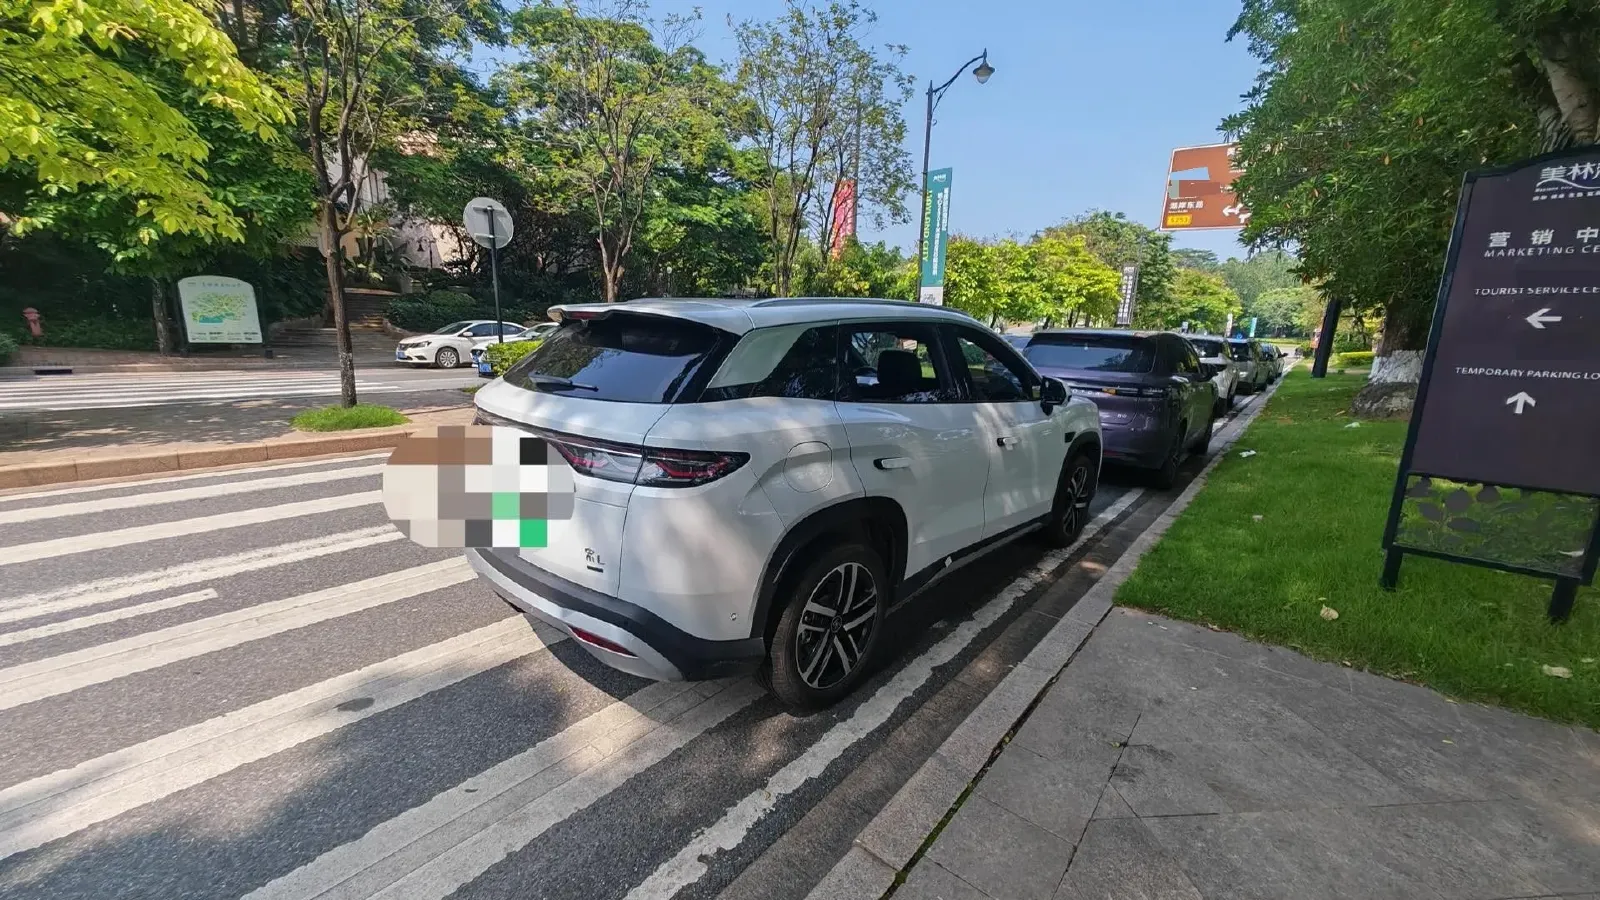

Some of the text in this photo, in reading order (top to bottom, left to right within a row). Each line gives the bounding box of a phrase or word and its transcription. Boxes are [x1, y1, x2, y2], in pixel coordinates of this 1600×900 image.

[922, 240, 930, 262] CITY
[1484, 246, 1575, 258] MARKETING
[1474, 287, 1524, 296] TOURIST
[1527, 286, 1580, 294] SERVICE
[1455, 366, 1524, 377] TEMPORARY
[1526, 370, 1581, 379] PARKING
